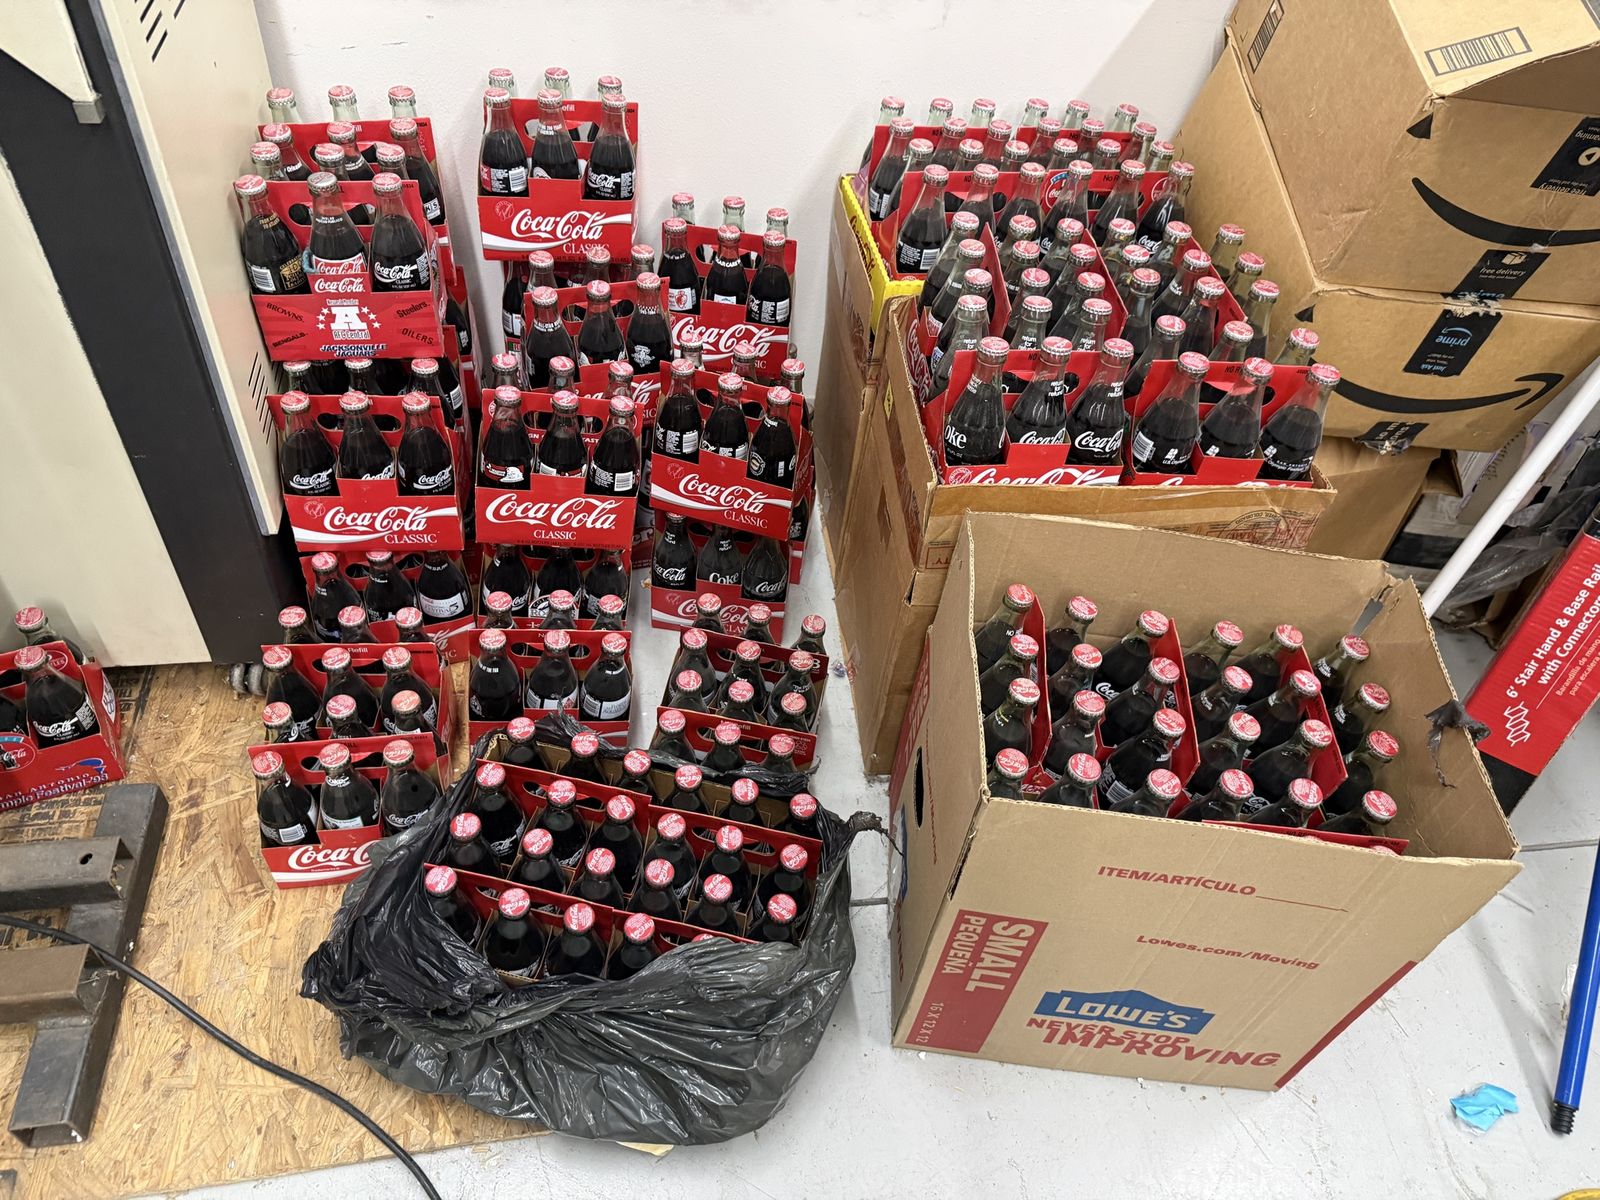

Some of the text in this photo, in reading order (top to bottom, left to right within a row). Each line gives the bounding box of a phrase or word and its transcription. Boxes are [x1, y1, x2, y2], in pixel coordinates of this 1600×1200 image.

[511, 210, 606, 240] Coca-Cola
[314, 277, 366, 293] Coca-Cola
[375, 262, 418, 283] Coca-Cola
[320, 344, 387, 352] JACKSONVILLE
[401, 328, 434, 345] OILERS
[1435, 335, 1471, 347] prime
[944, 425, 967, 449] oke
[291, 470, 332, 488] Coca-Cola
[679, 473, 767, 514] Coca-Cola
[323, 506, 429, 532] Coca-Cola
[485, 493, 622, 530] Coca-Cola
[724, 509, 768, 529] CLASSIC
[384, 534, 437, 544] CLASSIC
[533, 530, 576, 540] CLASSIC
[655, 564, 687, 581] ca-Cola
[709, 572, 739, 584] Coke
[1562, 589, 1590, 617] Base
[1555, 618, 1570, 628] &
[1533, 627, 1561, 660] Hand
[1515, 659, 1540, 687] Stair
[1537, 658, 1562, 685] with
[1555, 665, 1581, 696] Barandilla
[1578, 658, 1586, 666] de
[1569, 655, 1600, 696] para escalera
[1506, 683, 1519, 698] 6'
[36, 778, 87, 799] Festival
[288, 840, 378, 869] Coca-C
[1098, 866, 1256, 896] ITEM/ARTÍCULO
[941, 914, 987, 975] PEQUEÑA
[965, 920, 1035, 992] SMALL
[1136, 935, 1320, 970] Lowes.com/Moving
[930, 1003, 944, 1011] 16
[1055, 996, 1192, 1029] LOWE'S
[922, 1020, 937, 1028] 12
[1026, 1017, 1191, 1044] NEVER STOP
[916, 1035, 929, 1043] 12
[1043, 1028, 1281, 1066] IMPROVING
